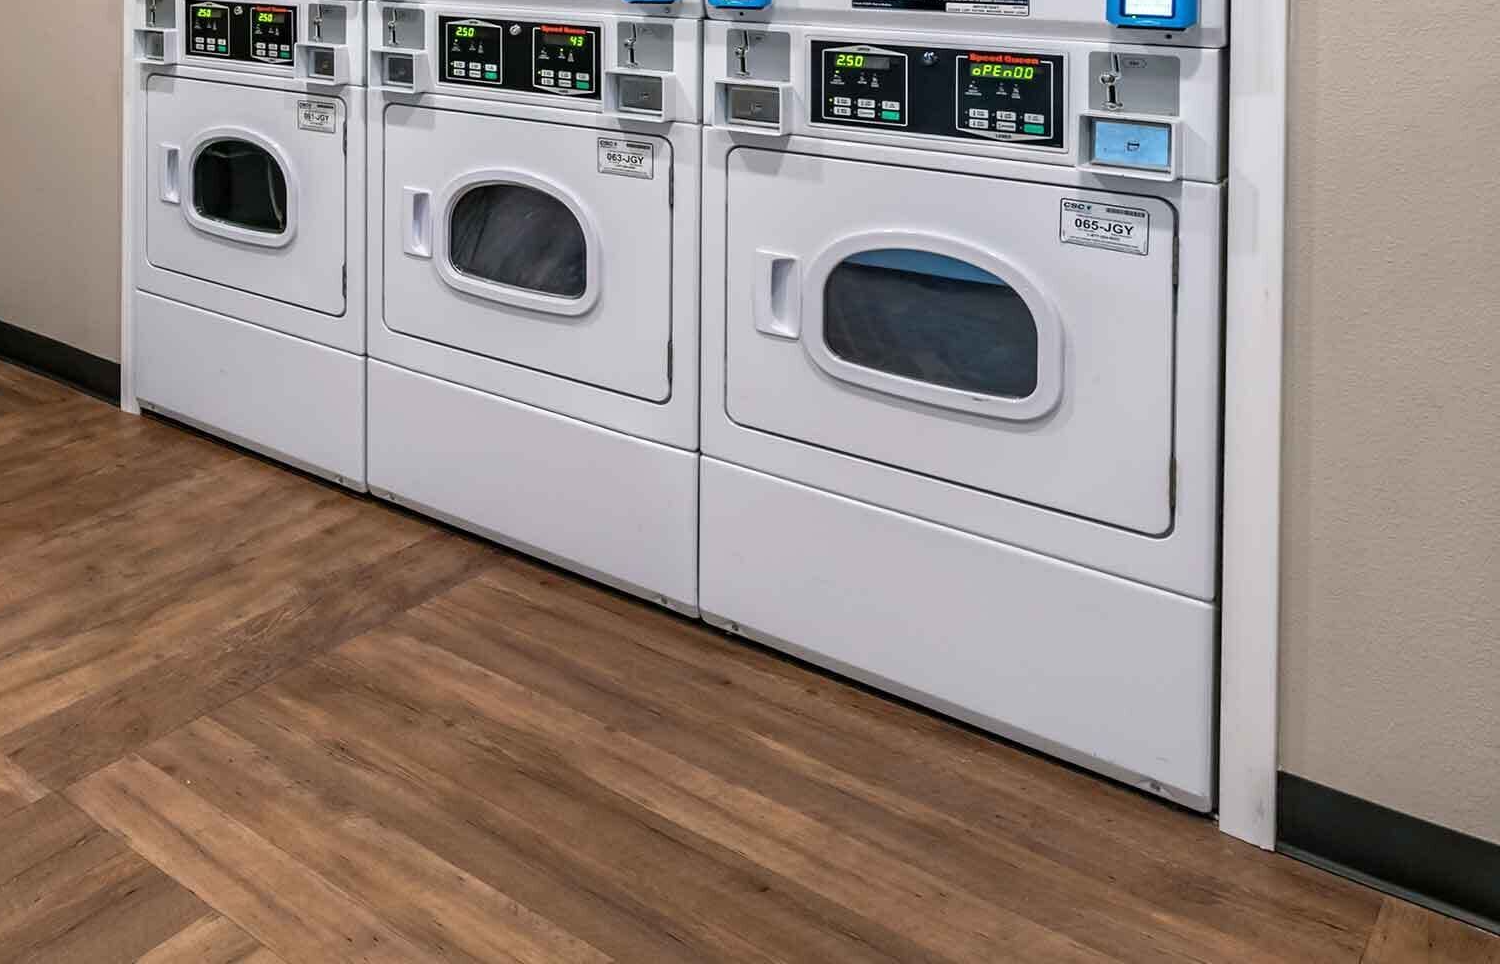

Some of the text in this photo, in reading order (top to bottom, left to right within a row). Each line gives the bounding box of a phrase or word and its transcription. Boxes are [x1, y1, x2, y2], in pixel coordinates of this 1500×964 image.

[569, 36, 584, 47] 43
[969, 53, 1039, 65] Speed Queen
[606, 152, 644, 165] 063-JGY
[1074, 218, 1135, 236] 065-JGY
